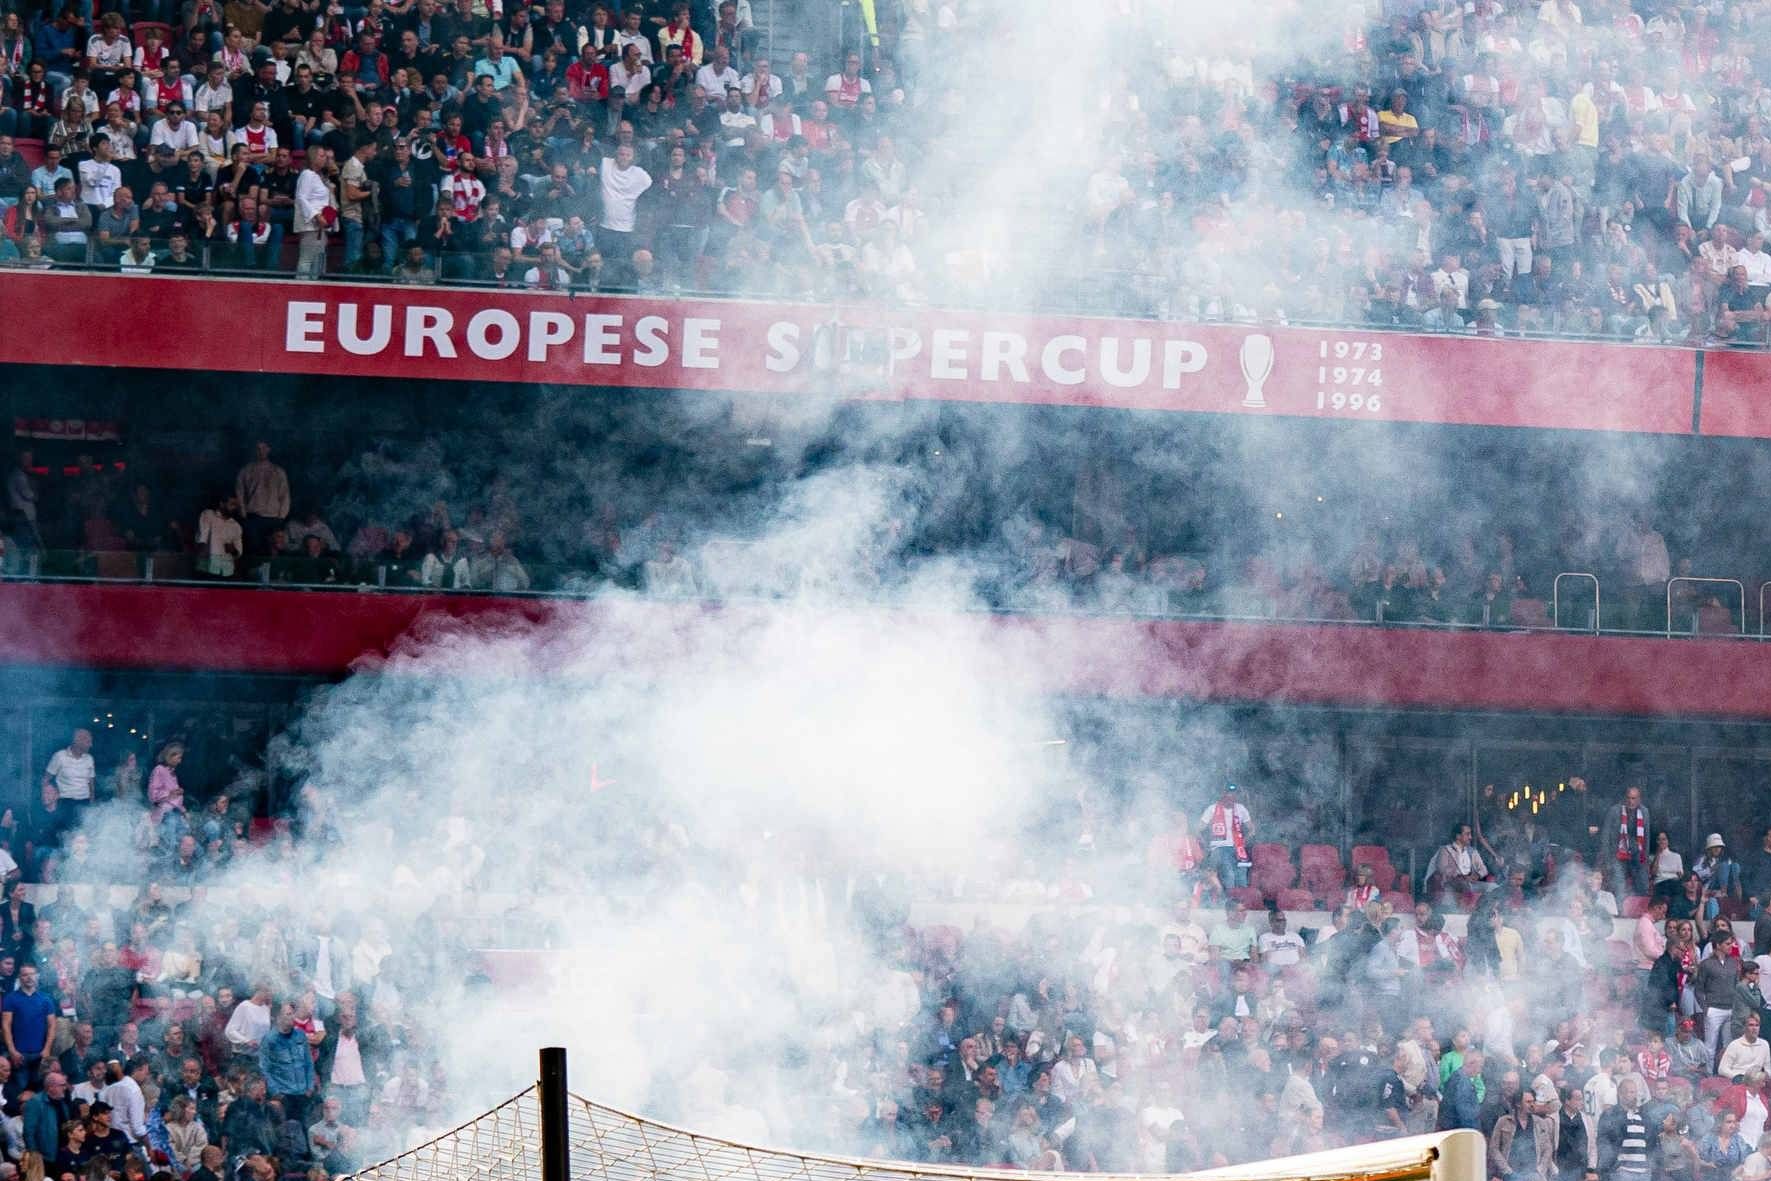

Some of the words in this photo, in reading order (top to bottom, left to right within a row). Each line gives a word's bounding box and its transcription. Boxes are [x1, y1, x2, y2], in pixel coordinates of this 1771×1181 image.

[286, 300, 721, 369] EUROPESE
[1320, 340, 1383, 361] 1973
[1319, 366, 1384, 387] 1974
[1316, 391, 1381, 412] 1996
